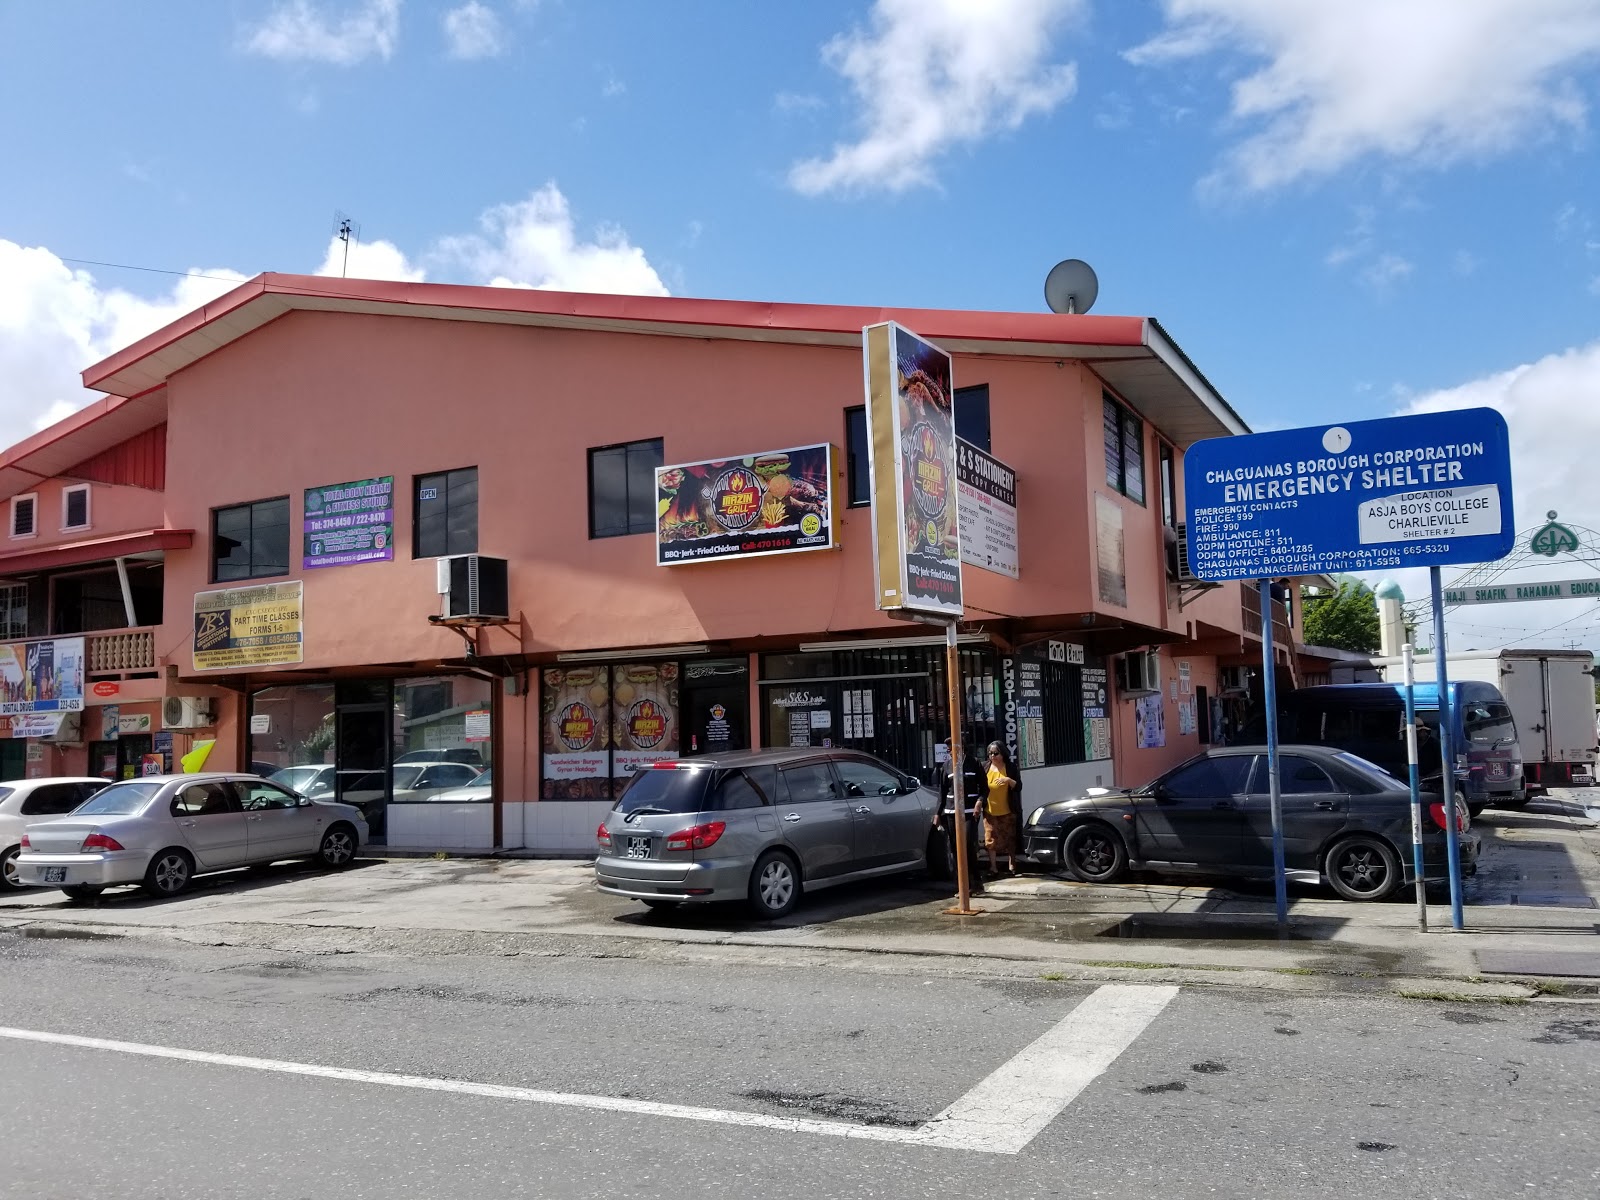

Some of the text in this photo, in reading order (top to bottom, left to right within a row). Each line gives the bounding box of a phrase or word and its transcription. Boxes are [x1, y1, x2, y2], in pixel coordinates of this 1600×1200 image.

[960, 446, 1014, 492] & S STATIONERY
[1206, 442, 1483, 483] CHAGUANAS BOROUGH CORPORATION
[918, 461, 941, 482] MAZIN
[923, 479, 938, 495] GRILL
[1225, 461, 1464, 502] EMERGENCY SHELTER
[324, 482, 391, 502] TOTAL BODY HEALTH
[421, 490, 436, 499] OPEN
[971, 474, 987, 490] COPY
[991, 485, 1014, 504] CENTER
[1402, 490, 1452, 501] LOCATION
[332, 499, 360, 513] FITNESS
[362, 495, 388, 508] STUDIO
[722, 492, 753, 506] MAZIN
[728, 505, 748, 514] GRILL
[1194, 500, 1298, 516] EMERGENCY CONTACTS
[1368, 498, 1489, 518] ASJA BOYS COLLEGE
[1196, 512, 1254, 524] POLICE: 999
[1388, 513, 1469, 529] CHARLIEVILLE
[312, 521, 322, 530] Tel:
[1196, 525, 1220, 533] FIRE:
[1196, 528, 1280, 542] AMBULANCE: 811
[1403, 529, 1442, 538] SHELTER
[682, 549, 694, 558] Jerk
[697, 546, 714, 556] Fried
[714, 544, 740, 553] Chicken
[757, 540, 772, 549] 470
[772, 539, 790, 547] 1616
[1196, 542, 1225, 550] ODPM
[1228, 538, 1274, 548] HOTLINE:
[1197, 550, 1226, 560] ODPM
[1228, 548, 1268, 558] OFFICE:
[1197, 558, 1260, 570] CHAGUANAS
[1264, 554, 1316, 564] BOROUGH
[1319, 547, 1400, 560] CORPORATION:
[942, 571, 957, 582] Chicken
[1198, 568, 1247, 578] DISASTER
[1250, 562, 1322, 575] MANAGEMENT
[1446, 582, 1600, 602] HAJI SHAFIK RAHAMAN EDUCA
[235, 611, 299, 625] PART TIME CLASSES
[250, 625, 271, 635] FORMS
[3, 704, 19, 712] DIGITAL
[20, 702, 34, 712] DRUGS
[566, 722, 588, 731] MAZIN
[634, 720, 659, 729] MAZIN
[632, 837, 647, 848] PDC
[628, 848, 650, 859] 5057
